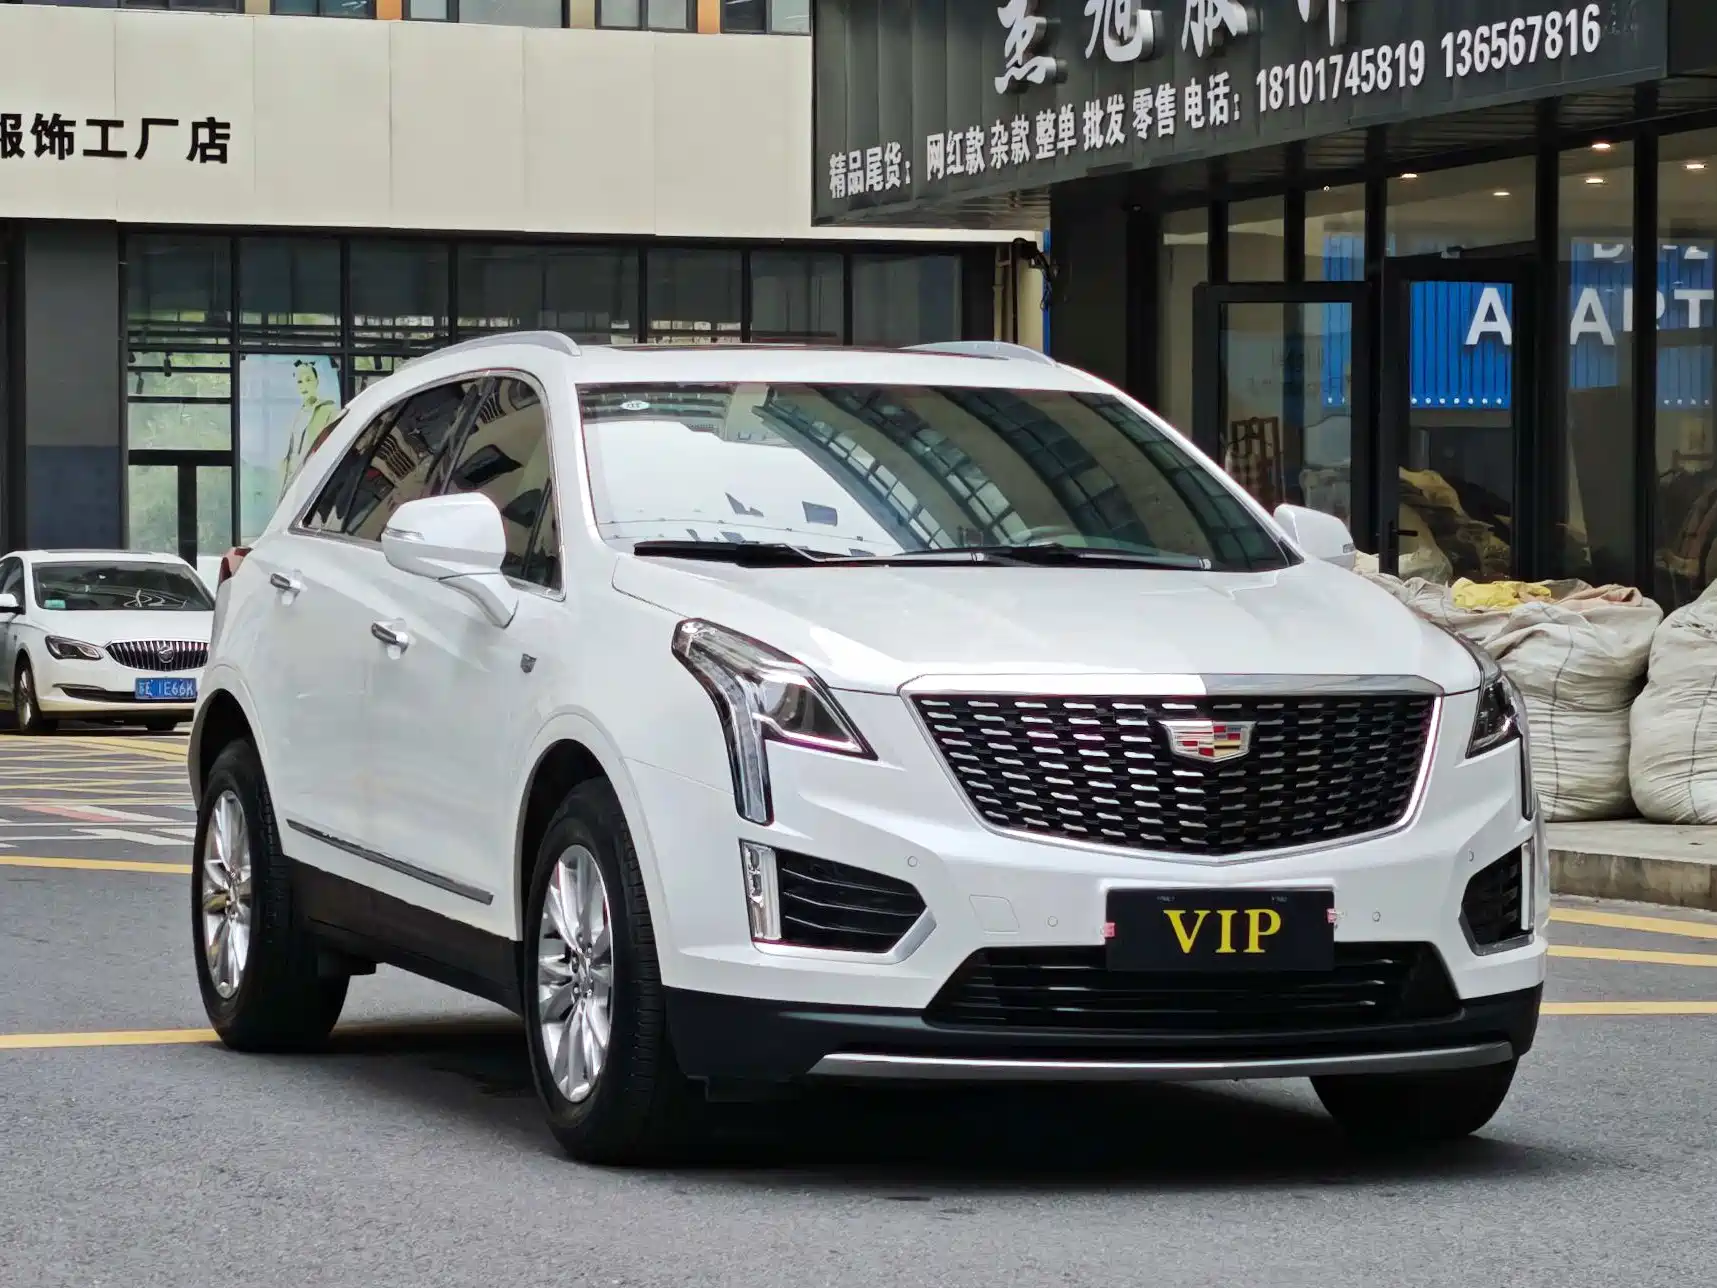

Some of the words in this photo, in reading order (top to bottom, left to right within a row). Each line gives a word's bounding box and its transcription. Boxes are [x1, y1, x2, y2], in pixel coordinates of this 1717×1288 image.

[926, 126, 985, 181] 网红款
[989, 115, 1030, 169] 杂款
[1035, 103, 1077, 160] 整单
[1082, 93, 1126, 151] 批发
[1132, 82, 1177, 139] 零售
[1256, 40, 1425, 112] 18101745819
[1441, 3, 1600, 77] 136567816
[1163, 909, 1281, 954] VIP
